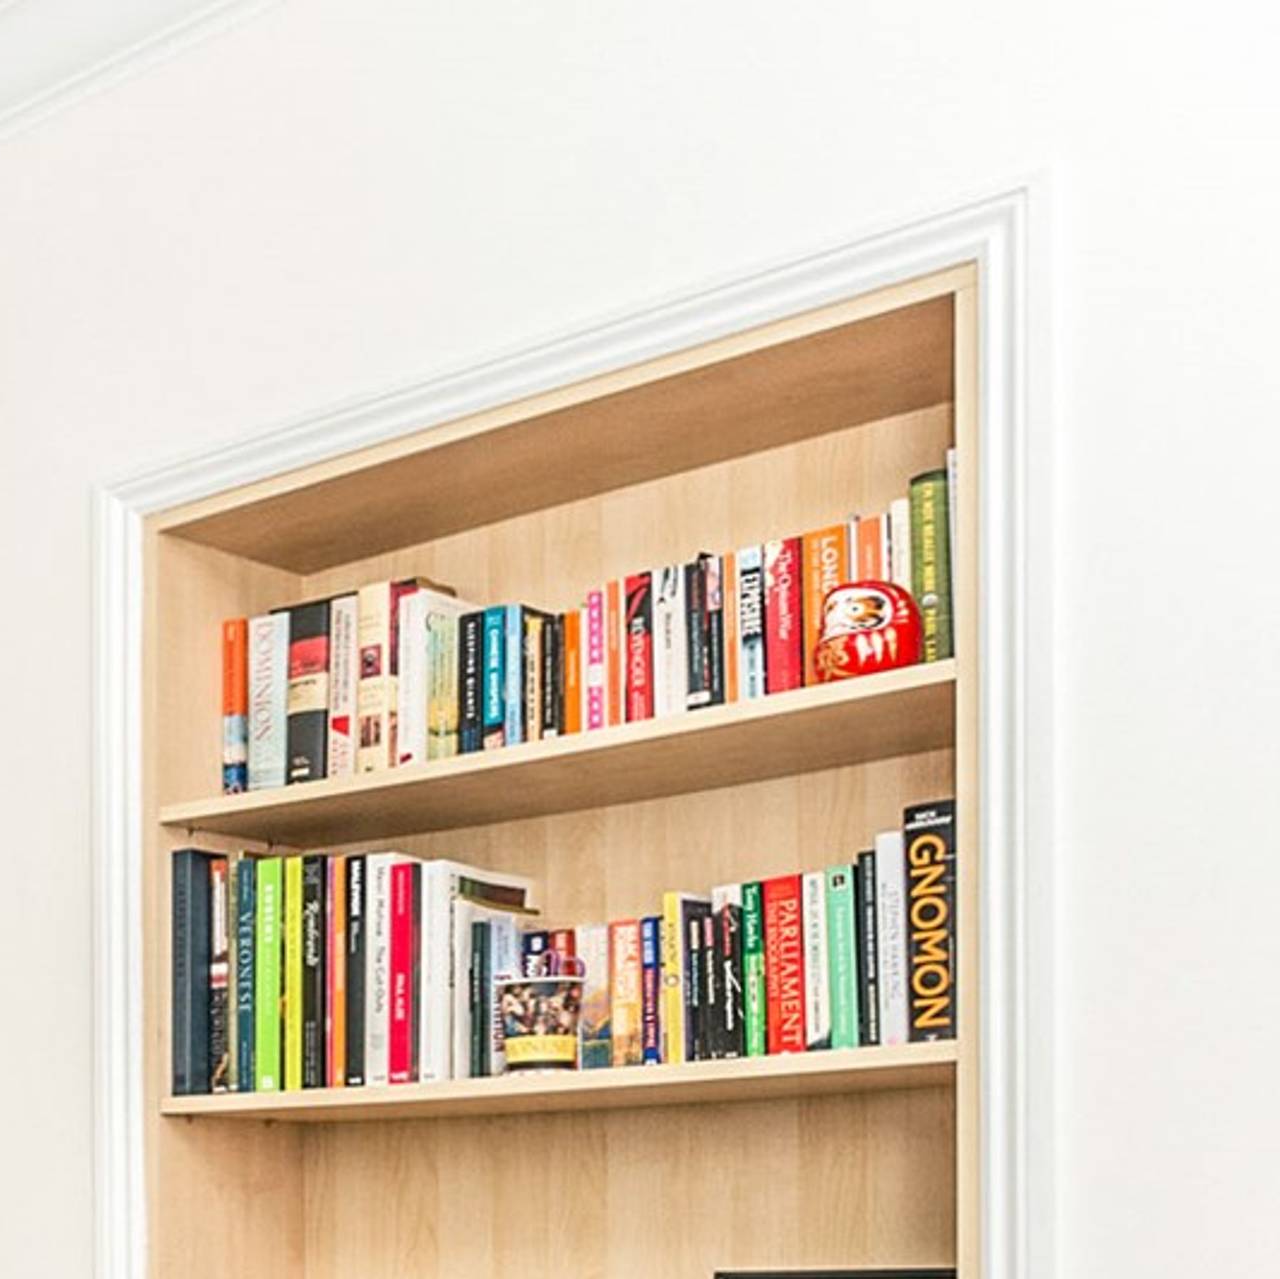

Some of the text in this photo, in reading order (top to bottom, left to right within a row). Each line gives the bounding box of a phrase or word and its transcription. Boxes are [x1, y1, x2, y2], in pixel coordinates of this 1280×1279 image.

[821, 536, 838, 593] LOND
[253, 622, 275, 741] DOMINION
[466, 621, 476, 719] SLEEPING GIANTS
[304, 900, 320, 966] Rembrandt
[350, 860, 361, 917] MALEVICH
[908, 834, 951, 1029] GNOMON
[238, 912, 252, 1014] VERONESE
[779, 897, 801, 1045] PARLIAMENT
